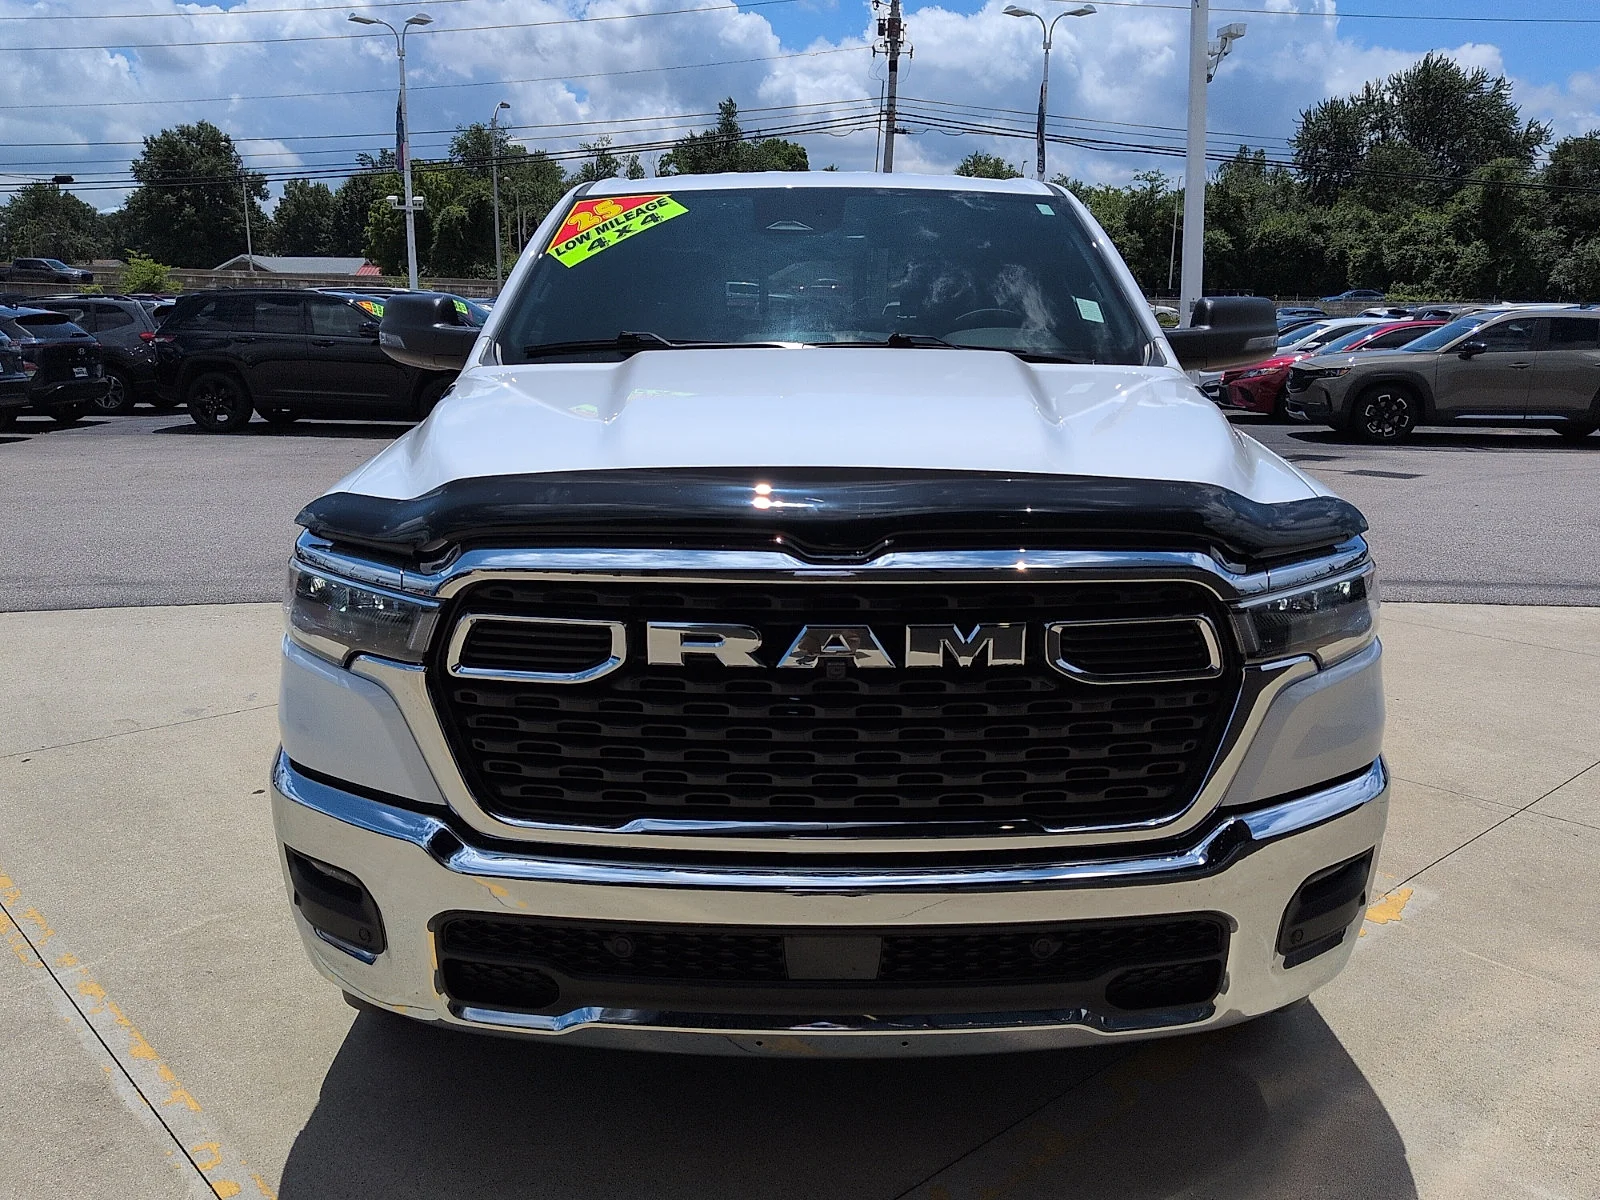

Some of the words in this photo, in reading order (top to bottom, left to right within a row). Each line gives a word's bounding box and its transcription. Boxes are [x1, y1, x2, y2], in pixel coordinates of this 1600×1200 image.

[554, 233, 591, 256] LOW
[594, 198, 669, 235] MILEAGE
[567, 199, 623, 231] 25
[587, 236, 611, 252] 4
[640, 212, 664, 226] 4
[646, 621, 1027, 669] RAM
